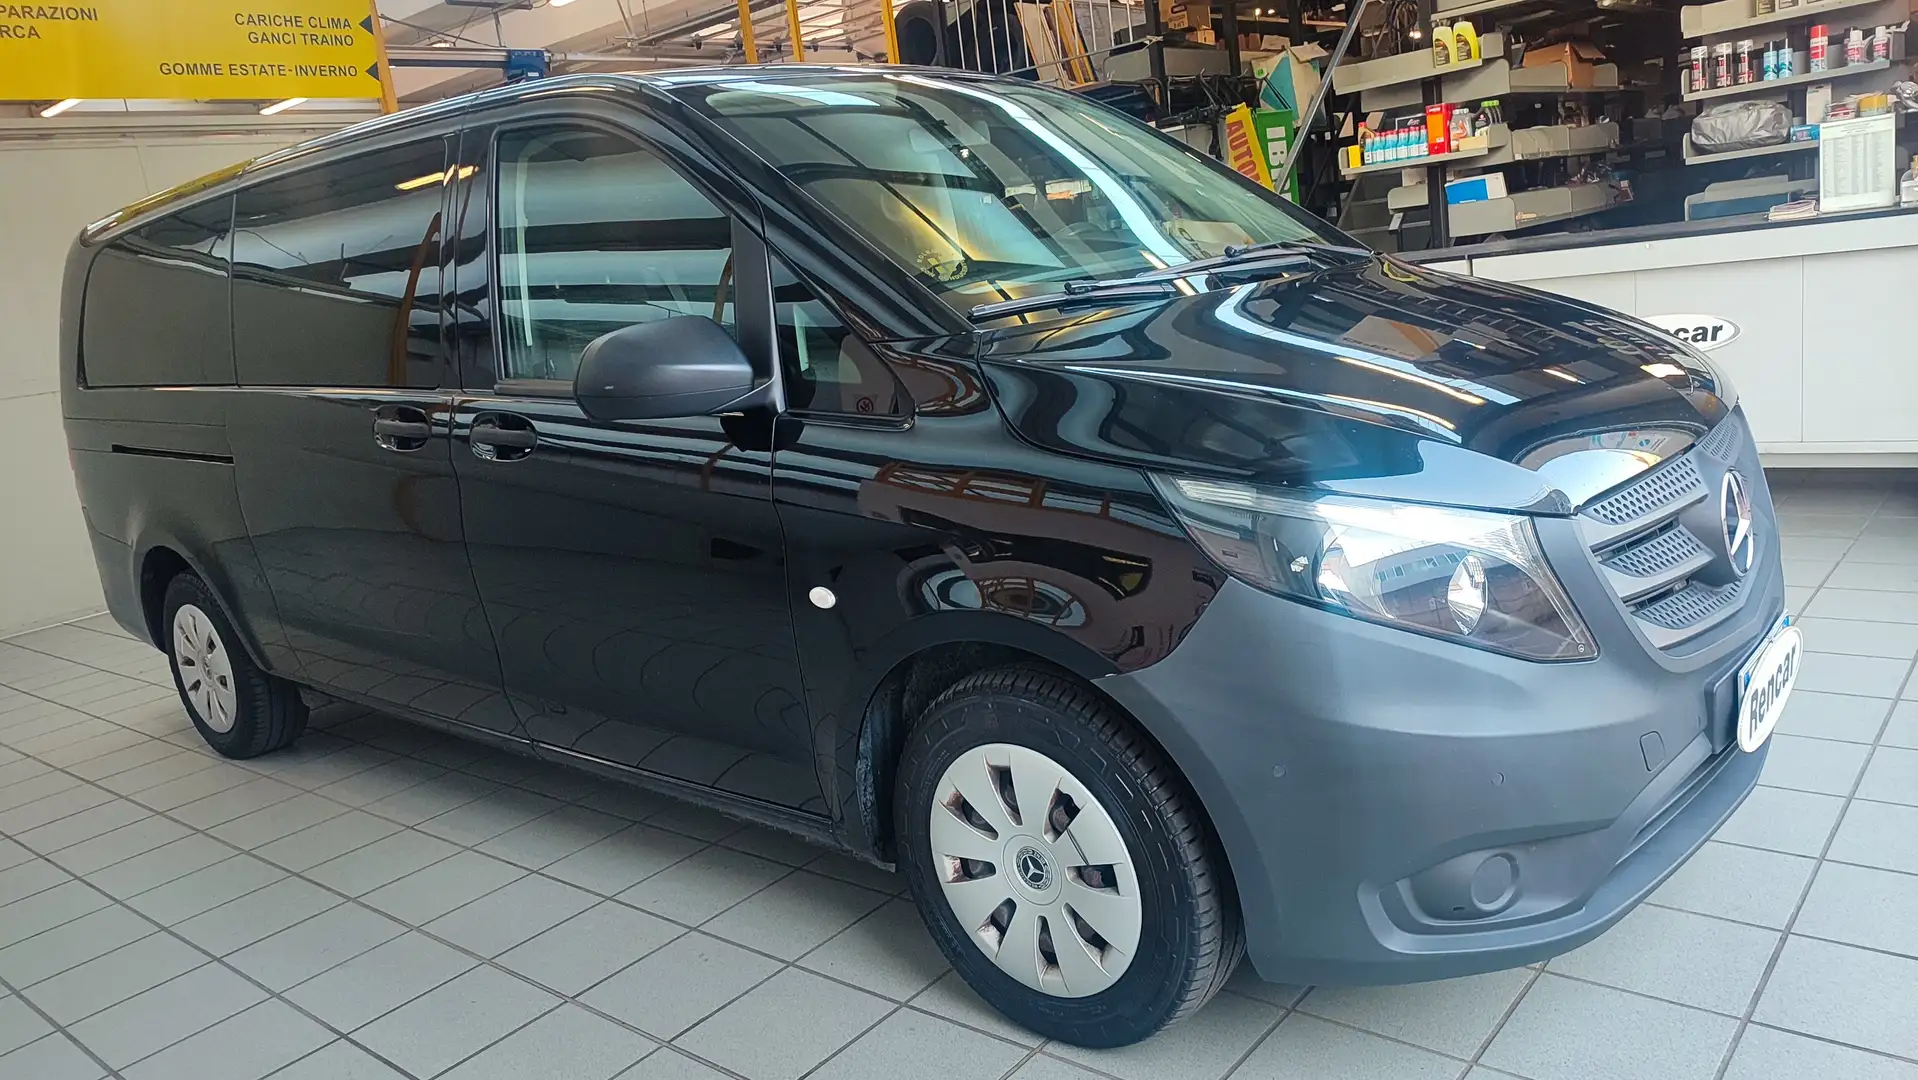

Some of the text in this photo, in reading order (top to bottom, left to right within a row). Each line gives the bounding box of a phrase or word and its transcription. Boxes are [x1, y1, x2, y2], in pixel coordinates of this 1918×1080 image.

[234, 13, 352, 30] CARICHE CLIMA
[0, 24, 41, 39] RCA
[248, 31, 354, 47] GANCI TRAINO
[159, 62, 358, 77] GOMME ESTATE-INVERNO
[1226, 119, 1261, 182] AUTO
[1664, 323, 1724, 343] car
[1749, 642, 1797, 742] Rencar
